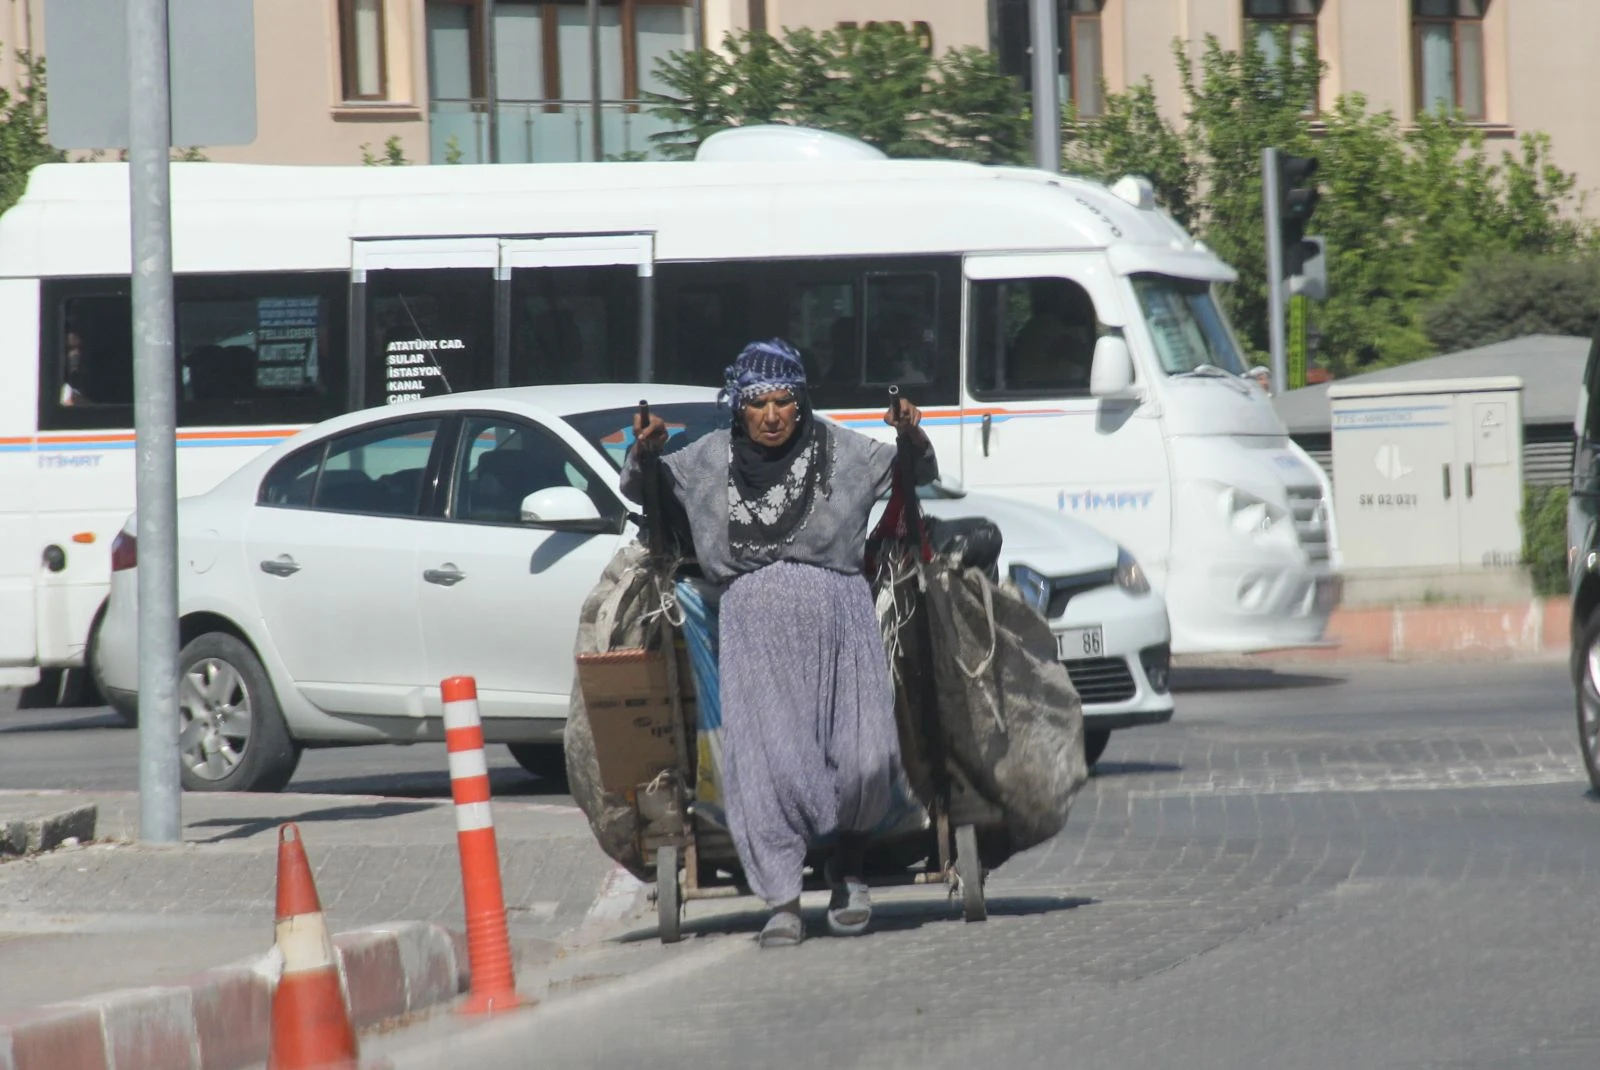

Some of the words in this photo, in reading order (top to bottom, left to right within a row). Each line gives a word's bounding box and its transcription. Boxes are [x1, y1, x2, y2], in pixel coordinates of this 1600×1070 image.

[387, 339, 437, 351] ATATÜRK
[439, 339, 465, 350] CAD.
[387, 354, 424, 365] SULAR
[387, 366, 441, 378] İSTASYON
[387, 380, 425, 391] KANAL
[1082, 631, 1100, 654] 86
